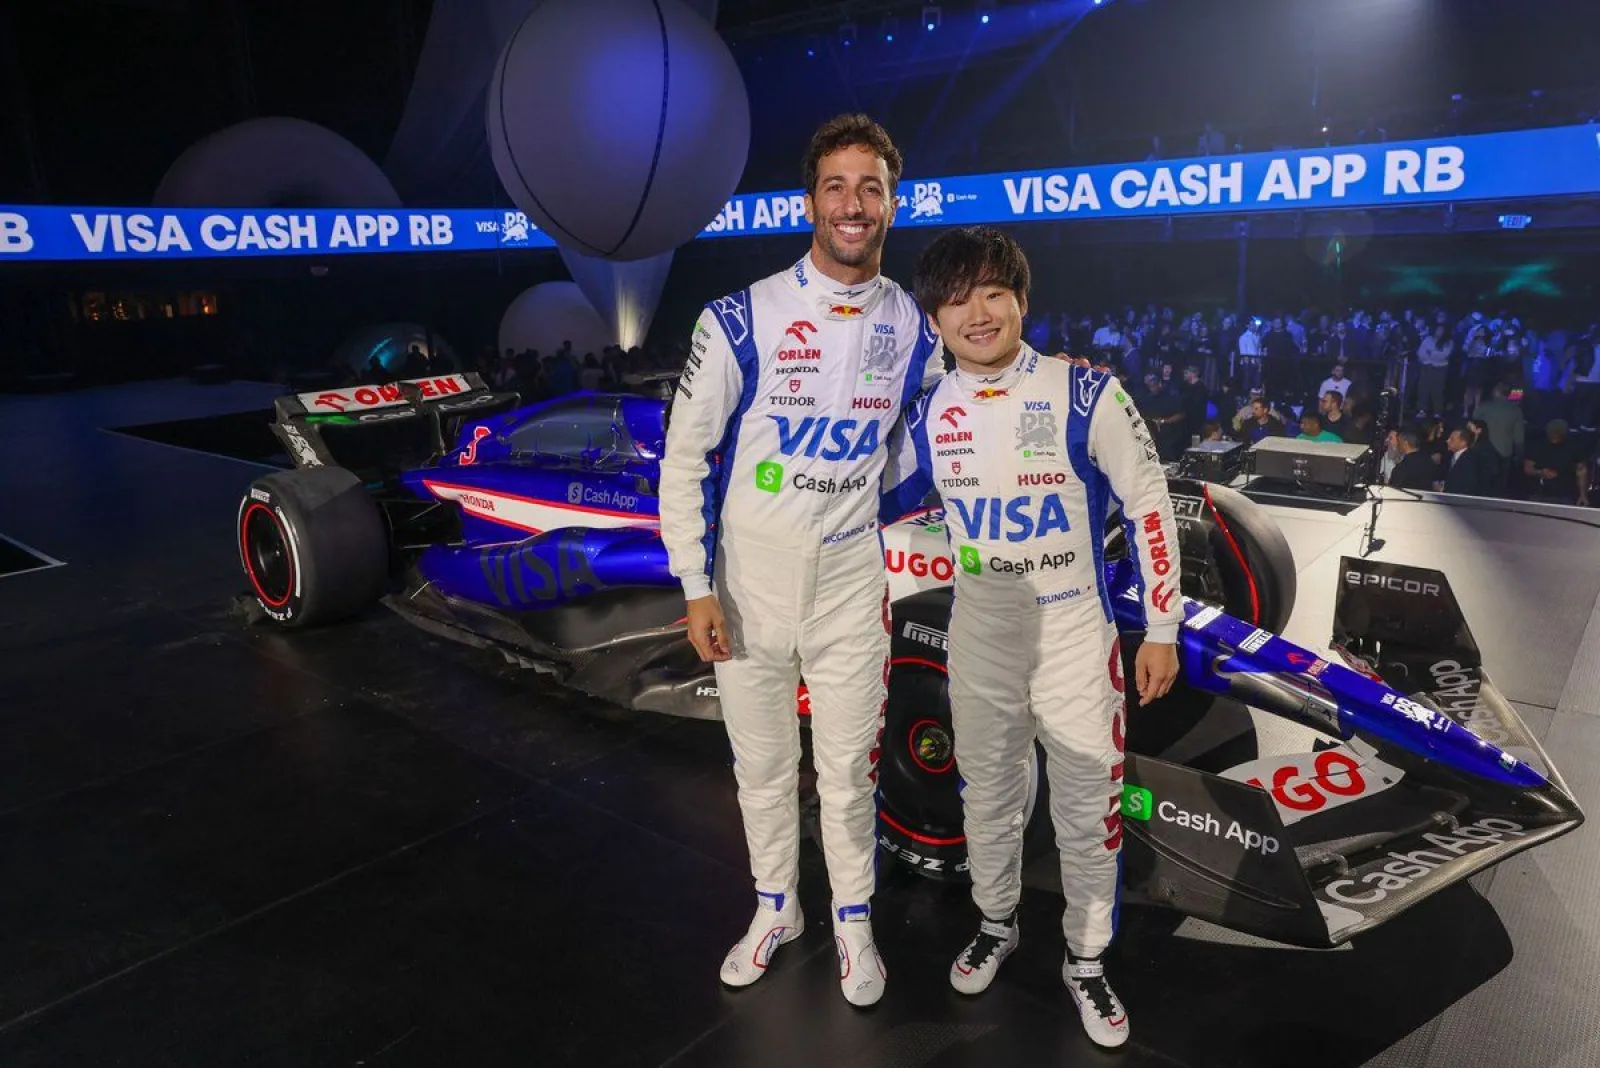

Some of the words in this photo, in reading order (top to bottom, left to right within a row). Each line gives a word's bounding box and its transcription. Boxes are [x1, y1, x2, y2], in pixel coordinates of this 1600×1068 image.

[1003, 172, 1101, 214] VISA
[1109, 161, 1243, 209] CASH
[1256, 152, 1367, 202] APP
[1383, 145, 1465, 195] RB
[752, 194, 806, 230] APP
[0, 211, 34, 253] B
[70, 213, 192, 253] VISA
[200, 214, 317, 252] CASH
[328, 214, 400, 249] APP
[409, 214, 453, 246] RB
[475, 220, 500, 233] VISA
[873, 323, 896, 336] VISA
[778, 348, 821, 362] ORLEN
[775, 366, 820, 375] HONDA
[770, 395, 816, 406] TUDOR
[851, 397, 892, 410] HUGO
[1023, 400, 1052, 411] VISA
[766, 414, 881, 461] VISA
[935, 431, 973, 445] ORLEN
[936, 447, 975, 457] HONDA
[792, 473, 836, 494] Cash
[839, 473, 868, 493] App
[941, 477, 980, 488] TUDOR
[1017, 472, 1067, 487] HUGO
[459, 494, 495, 511] HONDA
[584, 489, 610, 504] Cash
[611, 493, 637, 511] App
[947, 493, 1072, 543] VISA
[822, 526, 867, 545] RICCIARDO
[480, 531, 603, 605] VISA
[886, 548, 953, 581] UGO
[989, 555, 1034, 574] Cash
[1041, 550, 1076, 570] App
[1035, 587, 1081, 605] TSUNODA
[902, 620, 949, 651] PIREL
[1428, 659, 1481, 697] App
[1247, 750, 1367, 812] GO
[1157, 800, 1221, 837] Cash
[1224, 819, 1280, 856] App
[879, 834, 945, 872] ZER
[1324, 848, 1441, 906] Cash
[1421, 816, 1527, 862] App
